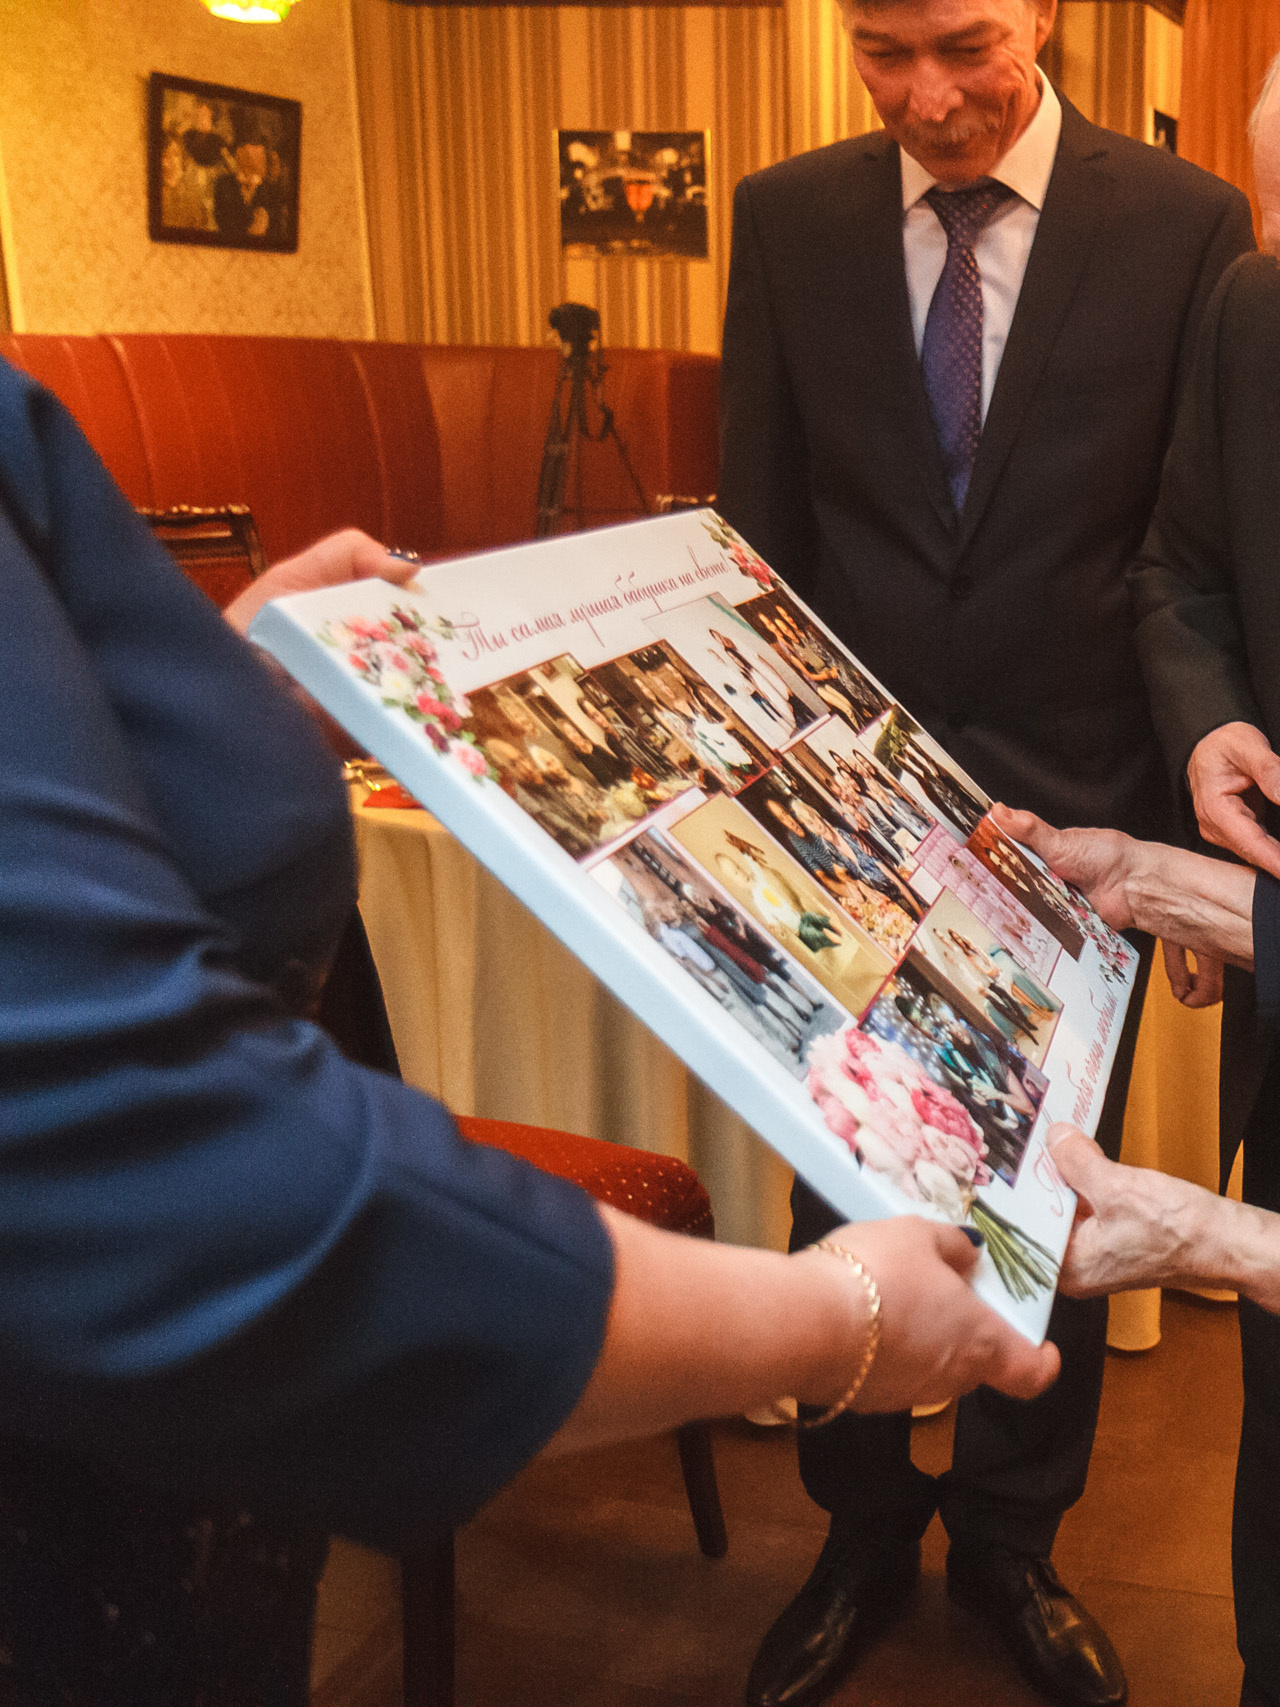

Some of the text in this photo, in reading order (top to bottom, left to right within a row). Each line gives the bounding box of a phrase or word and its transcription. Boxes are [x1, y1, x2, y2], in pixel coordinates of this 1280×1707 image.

[678, 572, 697, 588] на
[687, 545, 732, 581] свете!
[614, 570, 681, 613] бабушка
[511, 613, 566, 642] самая
[570, 595, 624, 648] лучшая
[1066, 1060, 1094, 1129] тебя
[1085, 1039, 1105, 1084] очень
